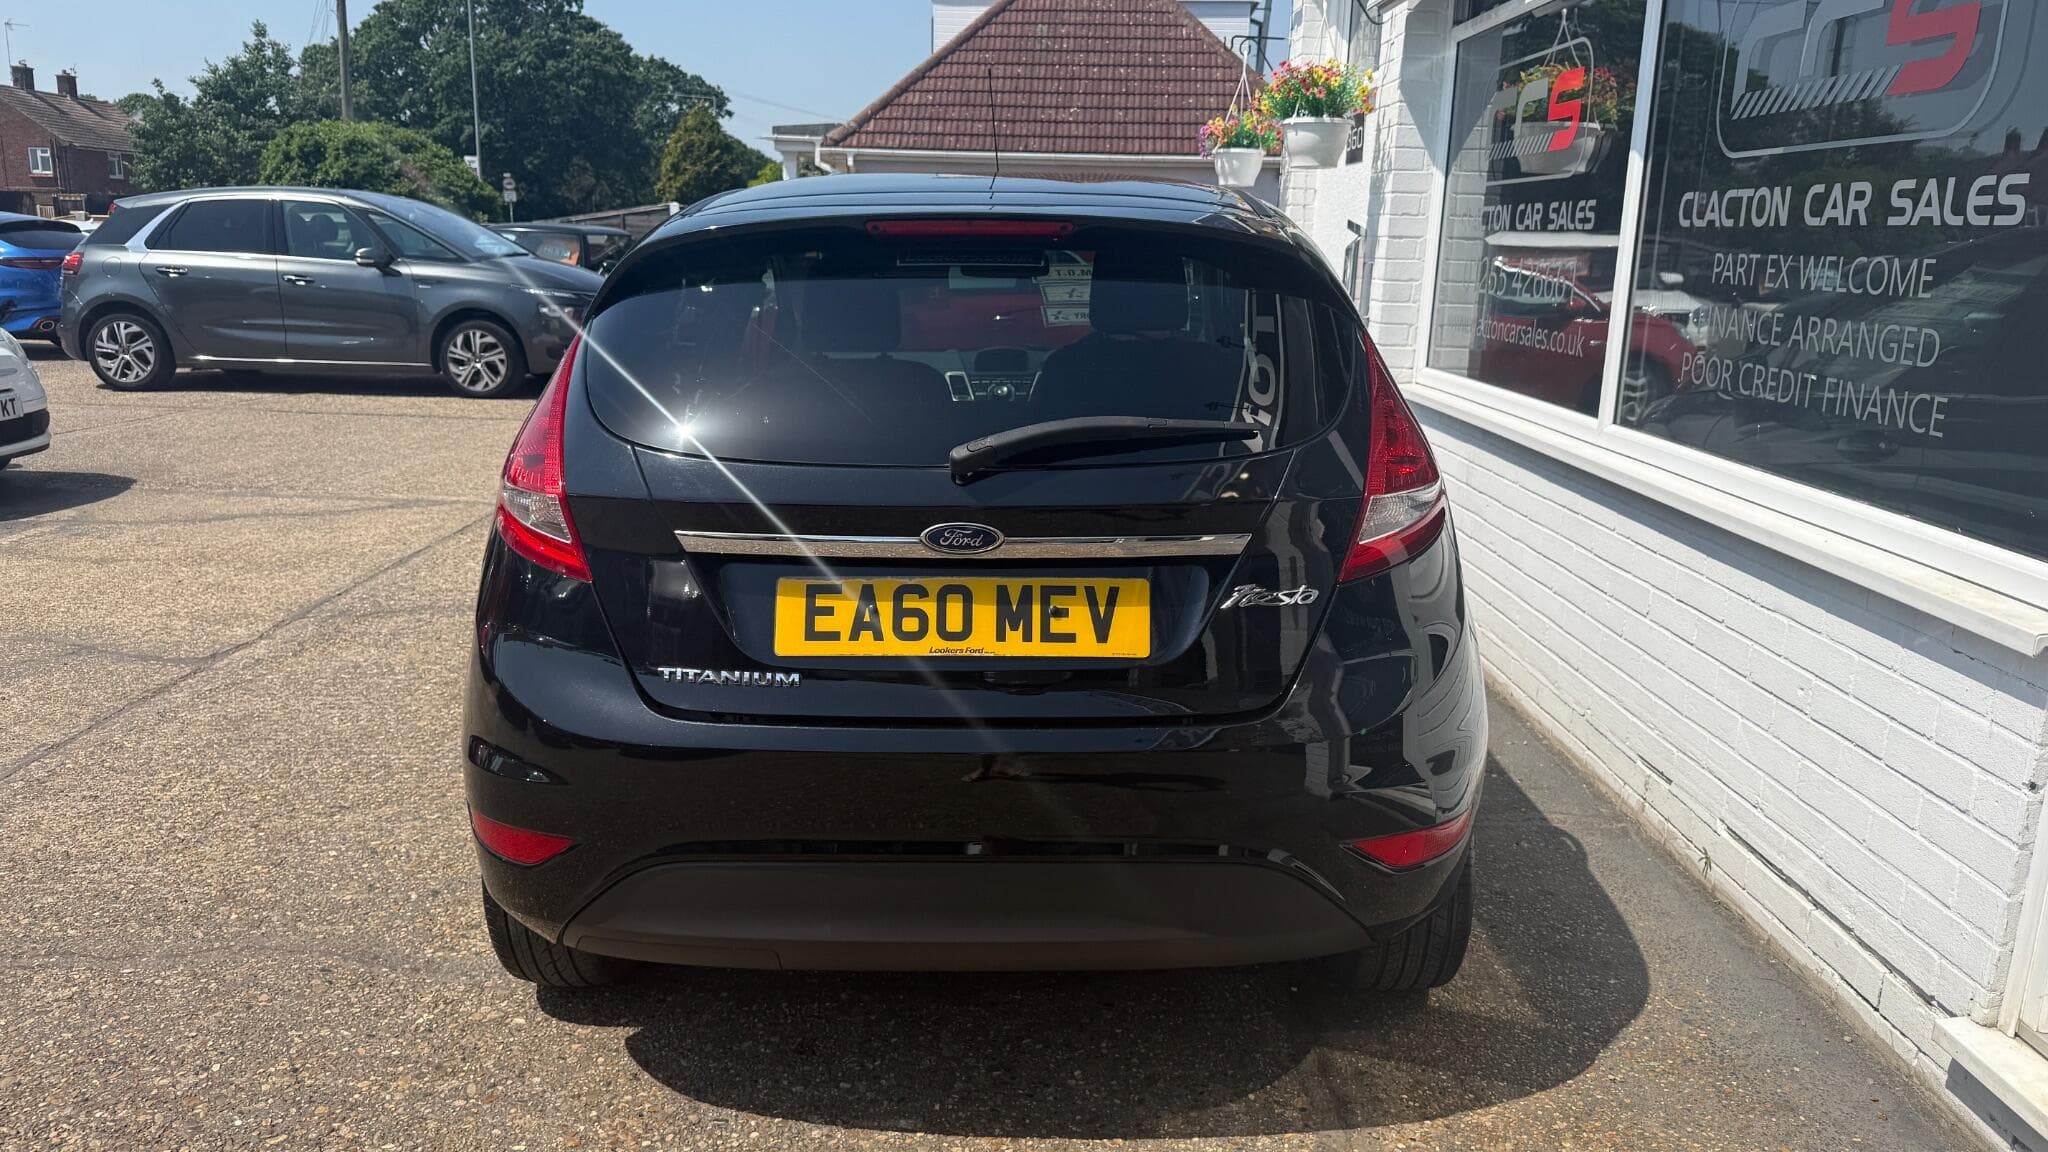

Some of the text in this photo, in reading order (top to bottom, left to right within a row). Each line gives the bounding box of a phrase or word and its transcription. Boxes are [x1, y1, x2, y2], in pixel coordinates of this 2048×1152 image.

[1515, 202, 1543, 231] CAR
[1547, 199, 1597, 231] SALES
[1678, 172, 2031, 228] CLACTON CAR SALES
[1711, 252, 1937, 298] PART EX WELCOME
[1708, 303, 1940, 368] INANCE ARRANGED
[1680, 351, 1949, 438] POOR CREDIT FINANCE
[939, 528, 984, 547] Ford
[803, 583, 1121, 644] EA60 MEV
[1219, 583, 1320, 609] Fiesta
[928, 646, 964, 655] Lookers
[964, 646, 985, 655] Ford
[657, 667, 800, 687] TITANIUM
